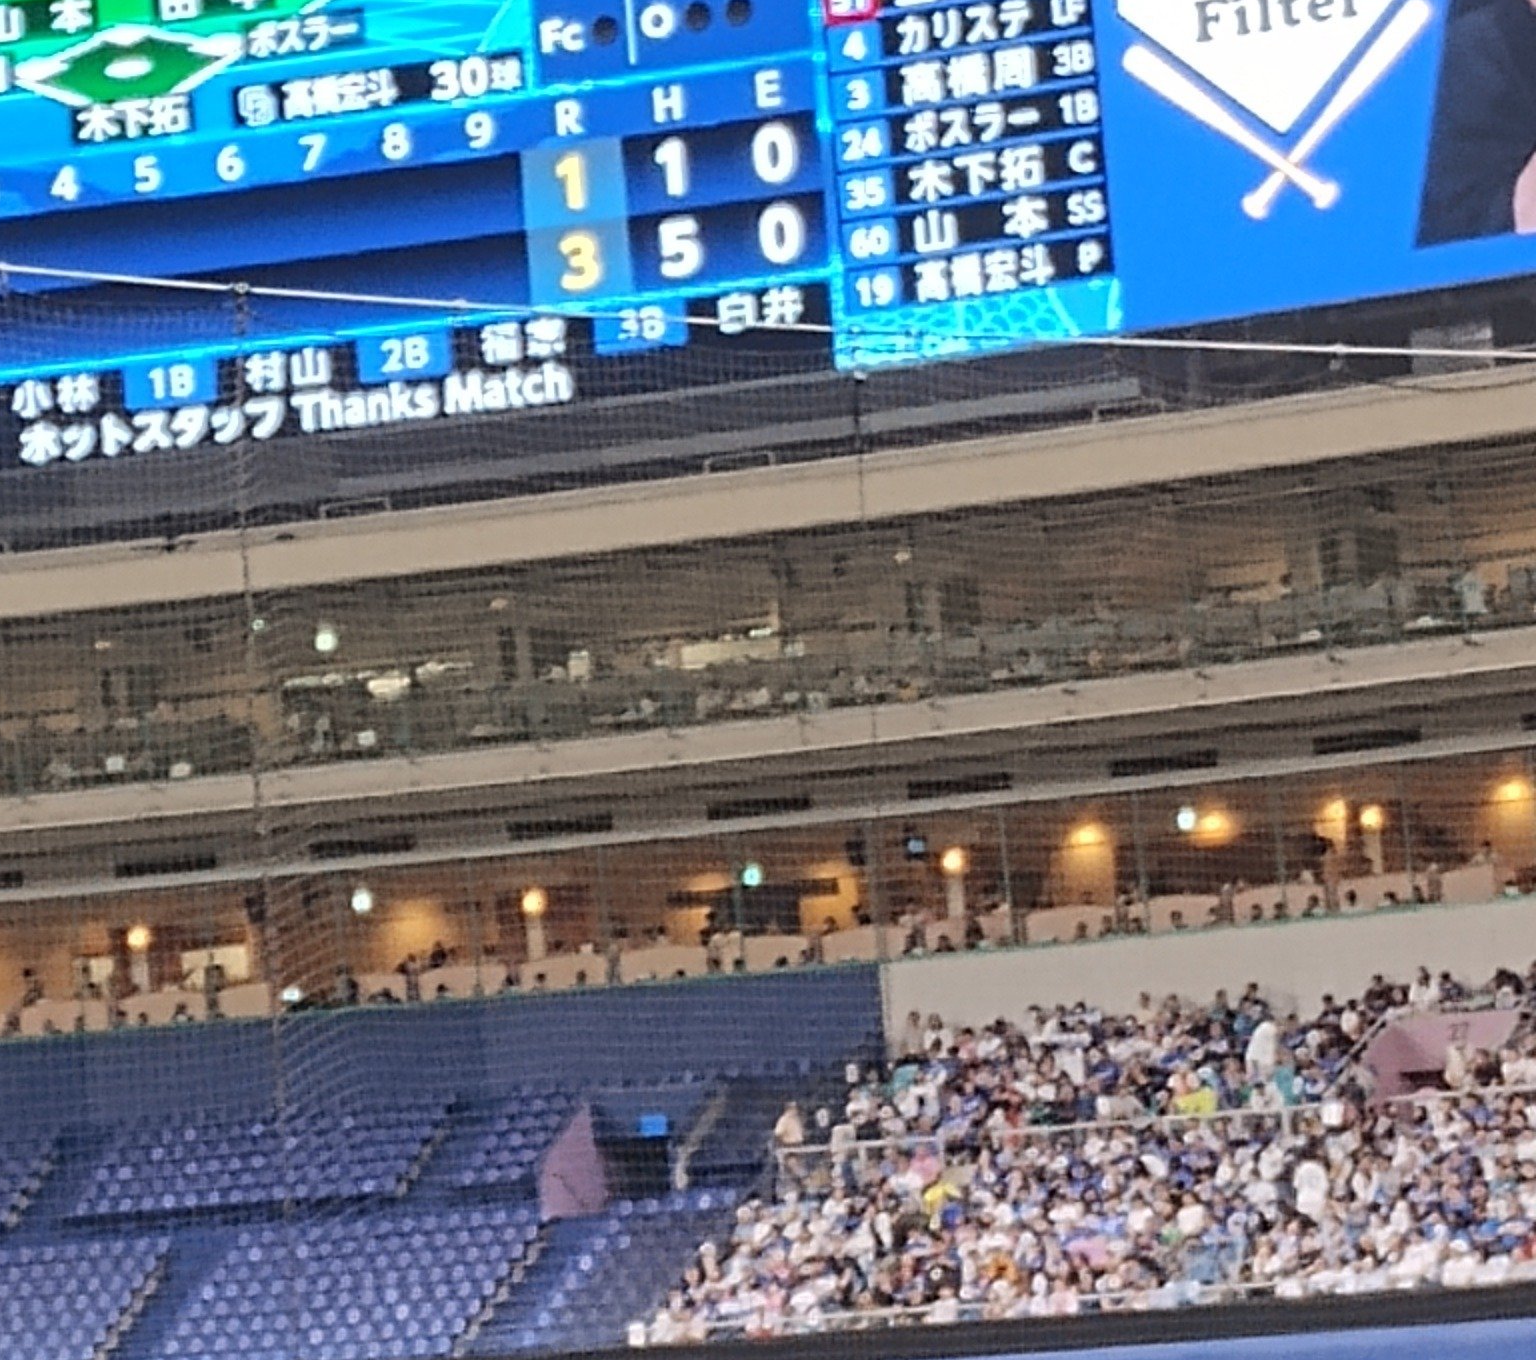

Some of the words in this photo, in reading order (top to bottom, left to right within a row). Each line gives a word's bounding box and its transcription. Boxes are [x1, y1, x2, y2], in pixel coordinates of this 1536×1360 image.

[248, 14, 359, 57] ボスラー
[639, 2, 675, 39] O
[842, 31, 868, 60] 4
[846, 79, 871, 110] 3
[1052, 40, 1094, 76] 3B
[50, 164, 79, 201] 4
[133, 154, 162, 193] 5
[215, 145, 246, 181] 6
[296, 133, 327, 171] 7
[381, 122, 411, 160] 8
[464, 111, 494, 149] 9
[554, 98, 585, 136] R
[651, 84, 684, 124] H
[754, 69, 783, 108] E
[77, 94, 190, 142] 木下拓
[841, 127, 882, 162] 24
[904, 101, 1041, 152] ボスラー
[1058, 90, 1098, 125] 1B
[555, 152, 587, 211] 1
[654, 137, 688, 197] 1
[752, 122, 798, 183] 0
[845, 176, 887, 211] 35
[908, 145, 1046, 203] 木下拓
[1068, 141, 1096, 174] C
[558, 230, 603, 290] 3
[658, 214, 703, 278] 5
[758, 201, 806, 265] 0
[913, 195, 1049, 254] 山本
[1066, 191, 1107, 226] SS
[855, 272, 895, 307] 19
[1076, 240, 1103, 273] P
[12, 372, 100, 420] 小林
[148, 363, 195, 400] 1B
[245, 348, 332, 393] 村山
[379, 336, 430, 374] 2B
[617, 305, 666, 341] 3B
[717, 285, 805, 335] 白井
[20, 395, 286, 466] ホットスタッフ
[289, 381, 440, 434] Thanks
[443, 361, 574, 416] Match
